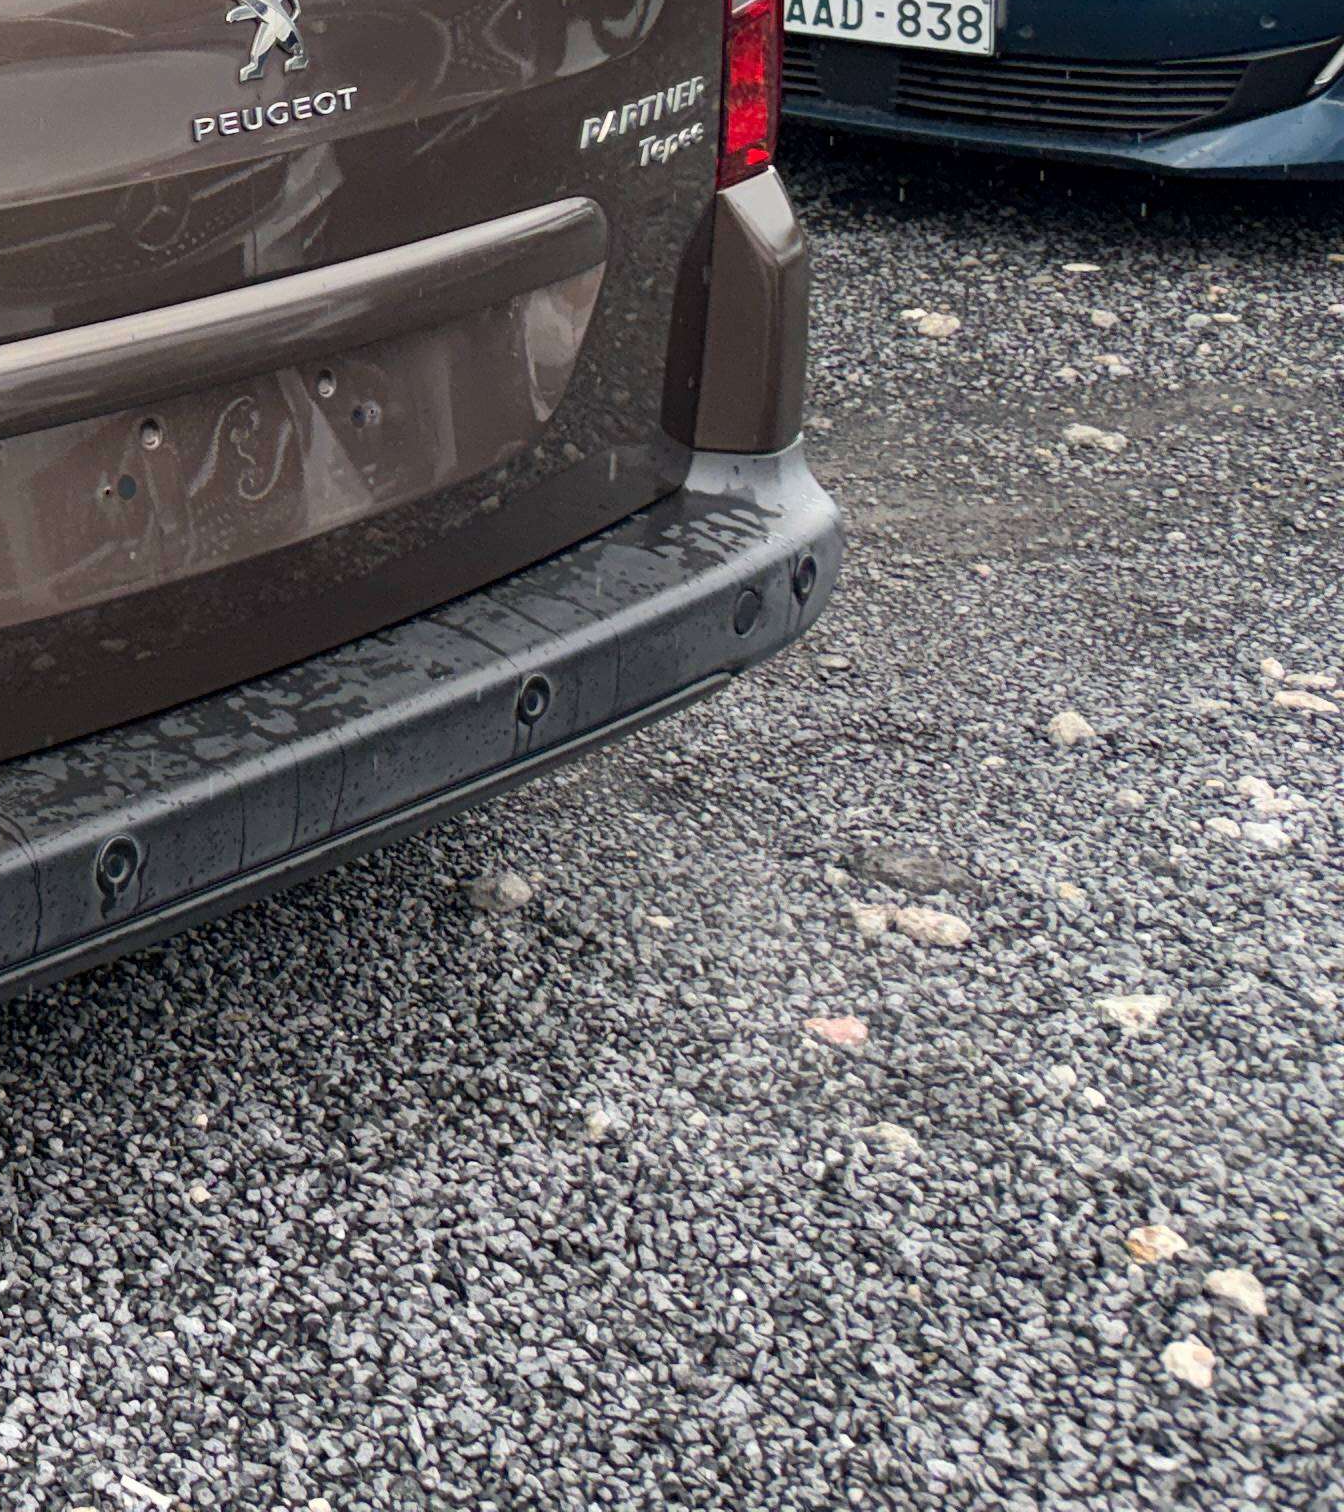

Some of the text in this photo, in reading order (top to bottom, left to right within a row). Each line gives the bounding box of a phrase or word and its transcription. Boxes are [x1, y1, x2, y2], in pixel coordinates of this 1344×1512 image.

[192, 87, 357, 142] PEUGEOT
[580, 76, 704, 149] PARTNER
[639, 122, 703, 166] Tepee
